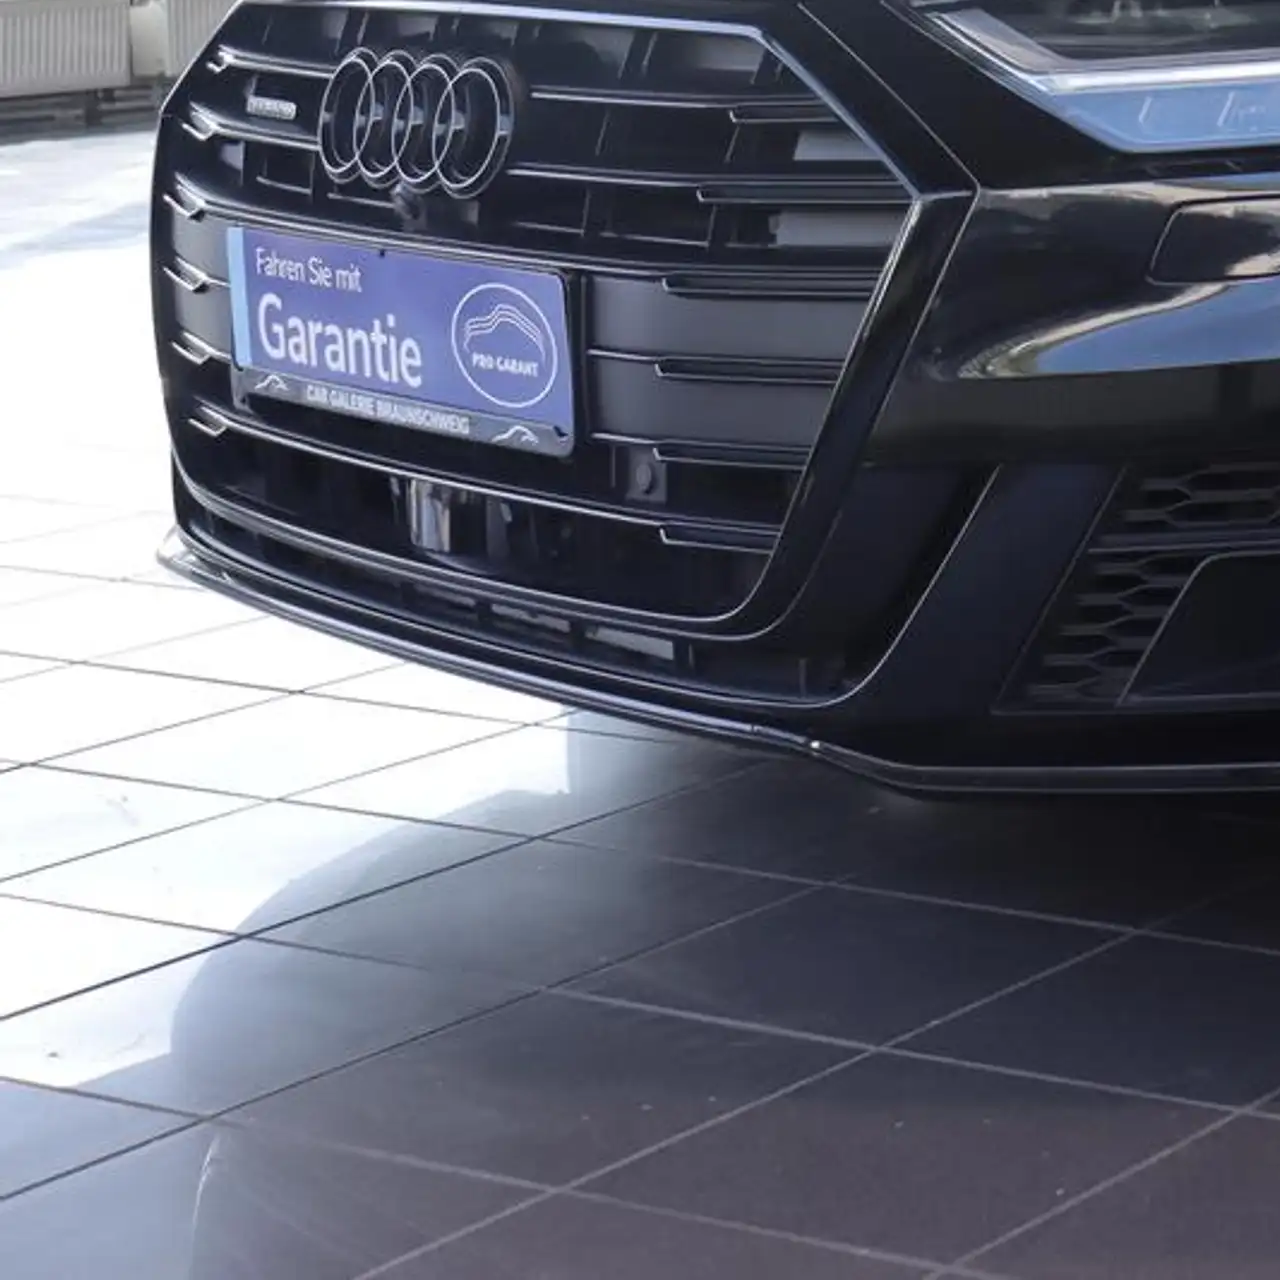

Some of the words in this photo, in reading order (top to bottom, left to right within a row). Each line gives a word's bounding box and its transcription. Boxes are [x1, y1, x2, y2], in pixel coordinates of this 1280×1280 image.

[256, 247, 305, 282] Fahren
[307, 256, 332, 287] Sie
[336, 263, 363, 293] mit
[258, 293, 423, 387] Garantie
[472, 352, 494, 370] PRO
[497, 356, 539, 378] GARANT
